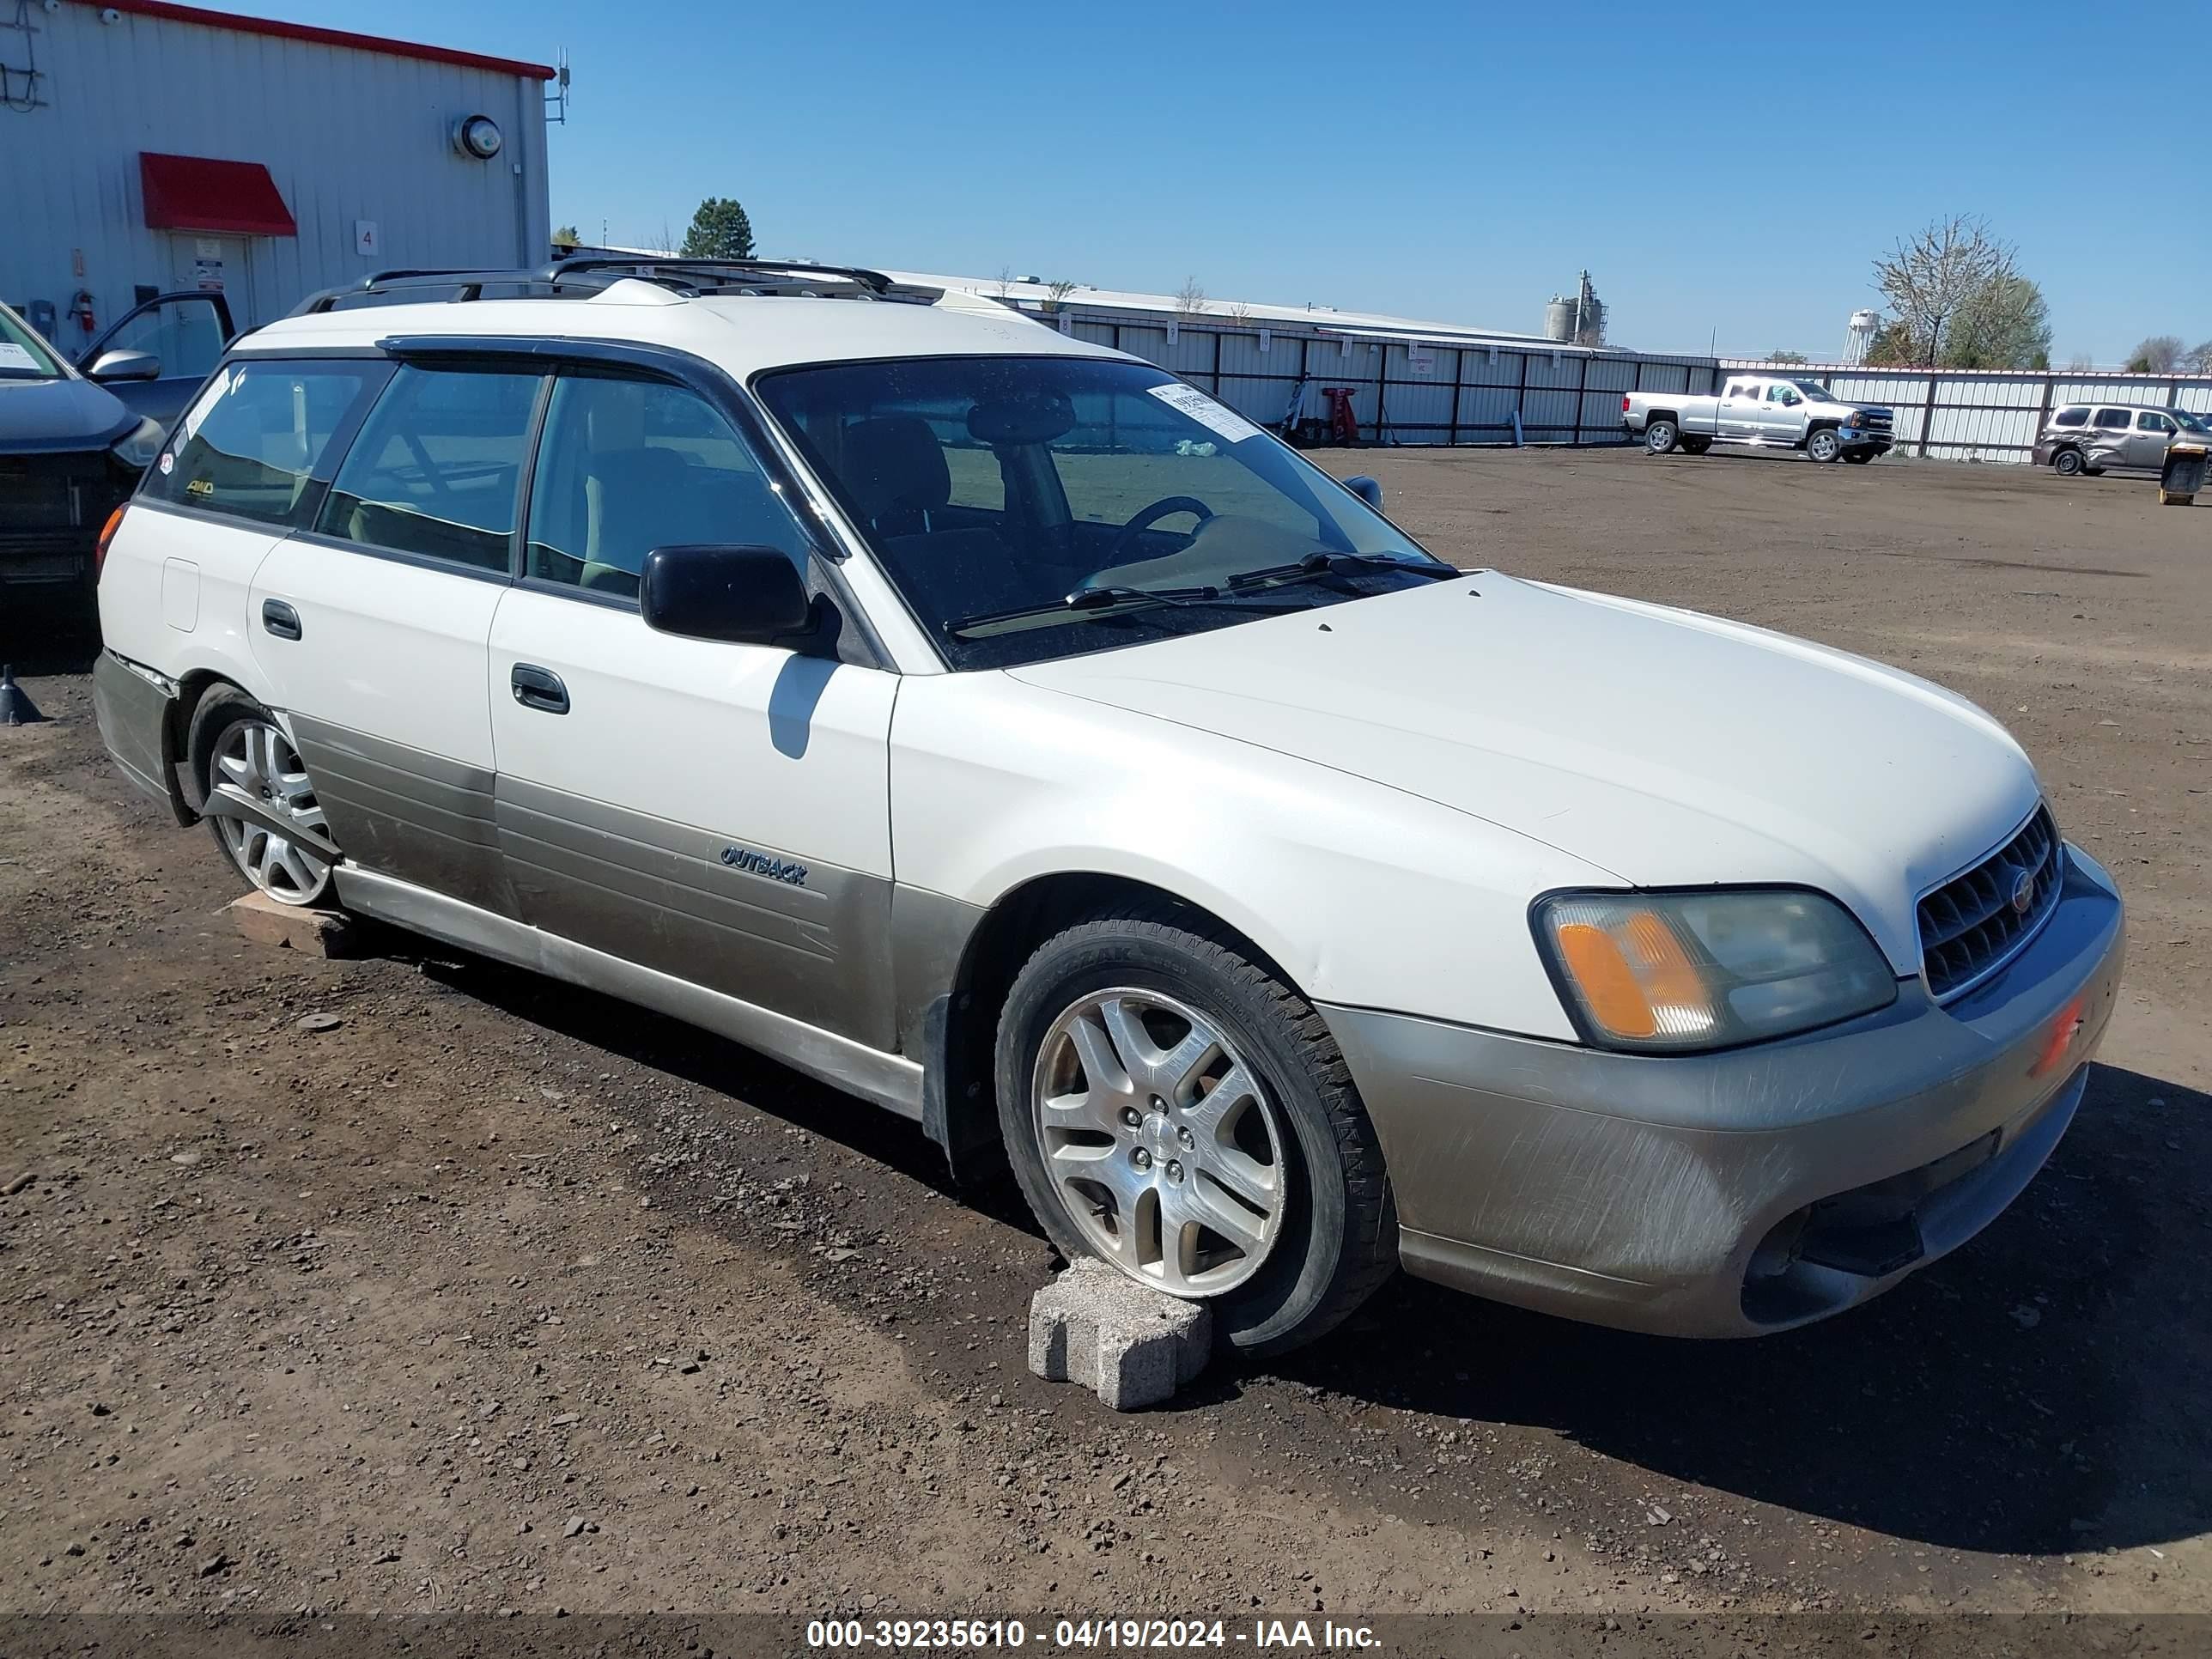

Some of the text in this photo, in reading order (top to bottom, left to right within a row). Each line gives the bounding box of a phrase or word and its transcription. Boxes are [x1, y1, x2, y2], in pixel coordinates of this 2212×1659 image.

[362, 230, 372, 247] 4
[1261, 334, 1269, 345] 10
[1410, 344, 1417, 355] 12
[185, 479, 215, 495] AWD
[720, 845, 809, 885] OUTBACK
